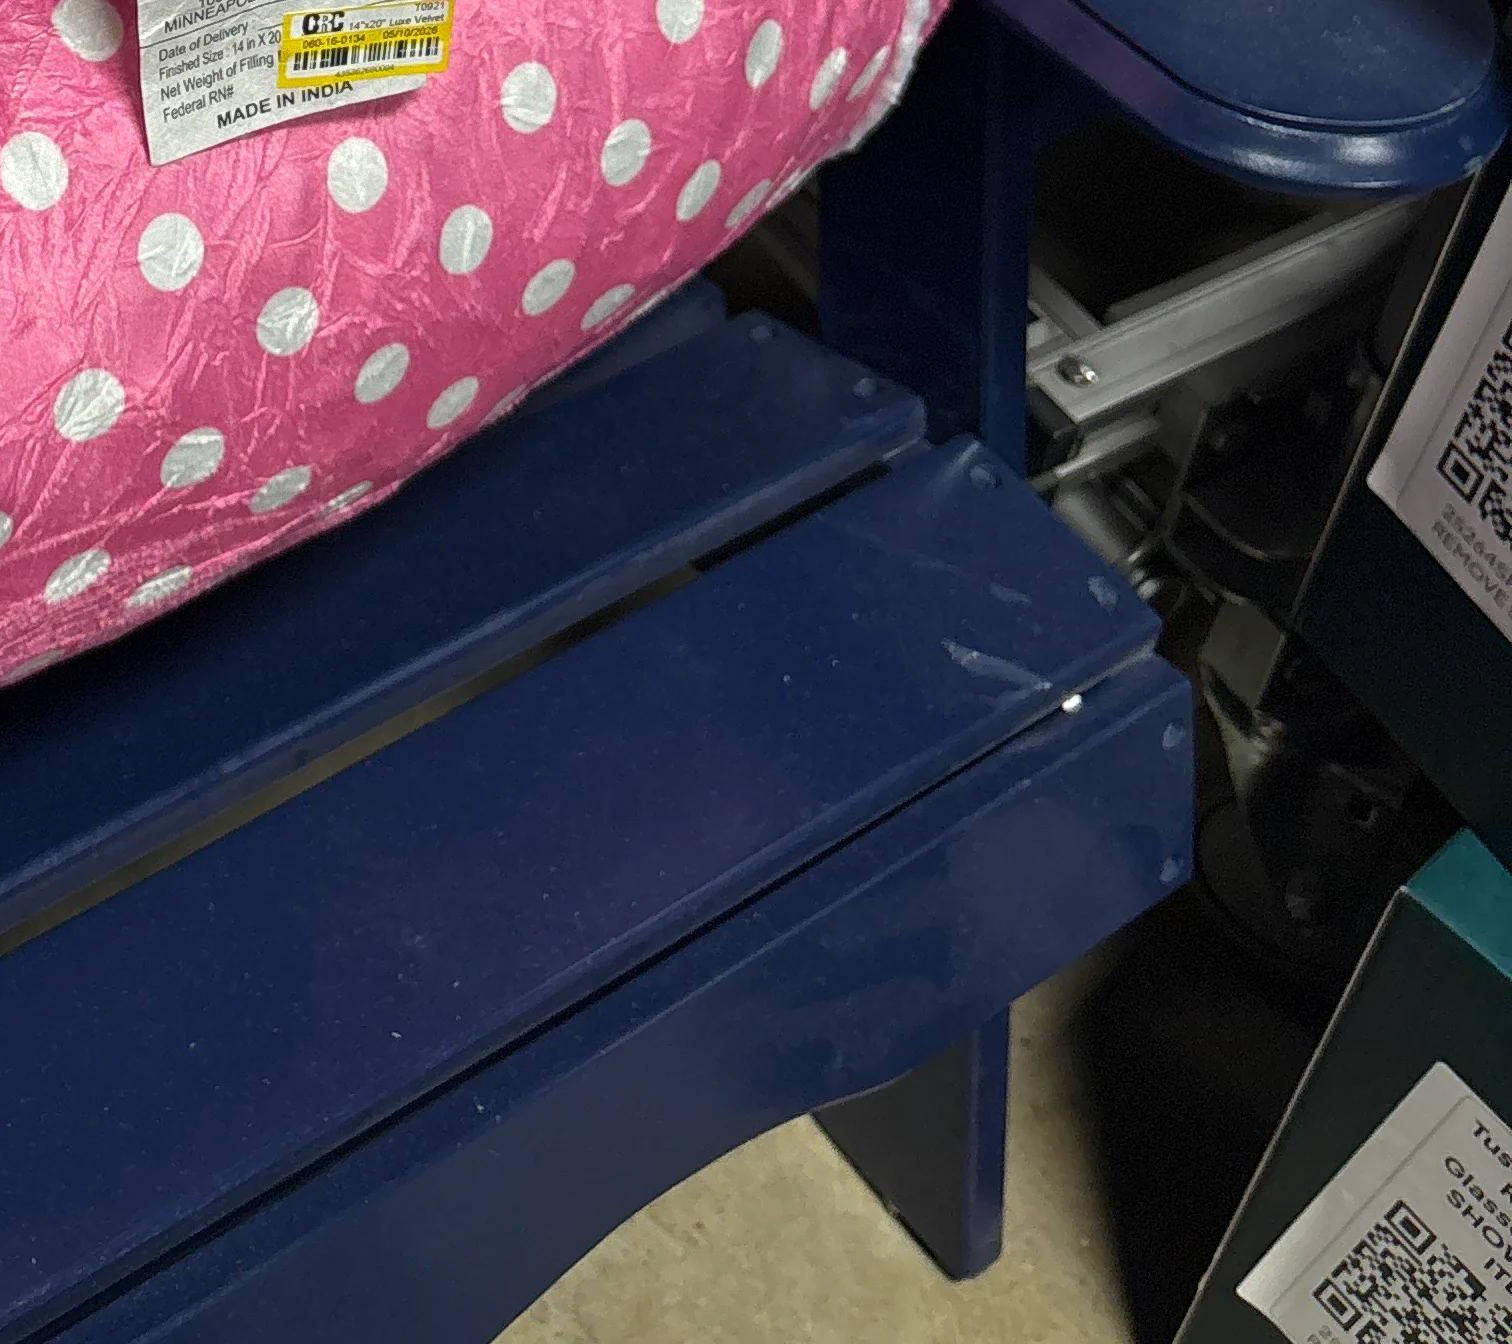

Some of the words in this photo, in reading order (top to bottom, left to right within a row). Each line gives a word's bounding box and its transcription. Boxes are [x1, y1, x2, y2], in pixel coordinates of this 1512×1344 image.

[159, 44, 187, 62] Date
[189, 39, 201, 52] of
[203, 23, 248, 46] Delivery
[389, 18, 412, 26] Luxe
[414, 14, 445, 23] Velvet
[159, 59, 201, 80] Finished
[202, 50, 223, 65] Size
[232, 43, 245, 54] 14
[248, 39, 255, 50] in
[258, 32, 266, 45] X
[268, 30, 281, 44] 20
[160, 82, 182, 101] Net
[184, 70, 224, 95] Weight
[226, 63, 238, 77] of
[239, 52, 274, 73] Filling
[163, 98, 206, 122] Federal
[208, 84, 234, 104] RN#
[217, 98, 272, 128] MADE
[276, 89, 295, 108] IN
[302, 80, 353, 102] INDIA
[1473, 1118, 1512, 1168] Tus
